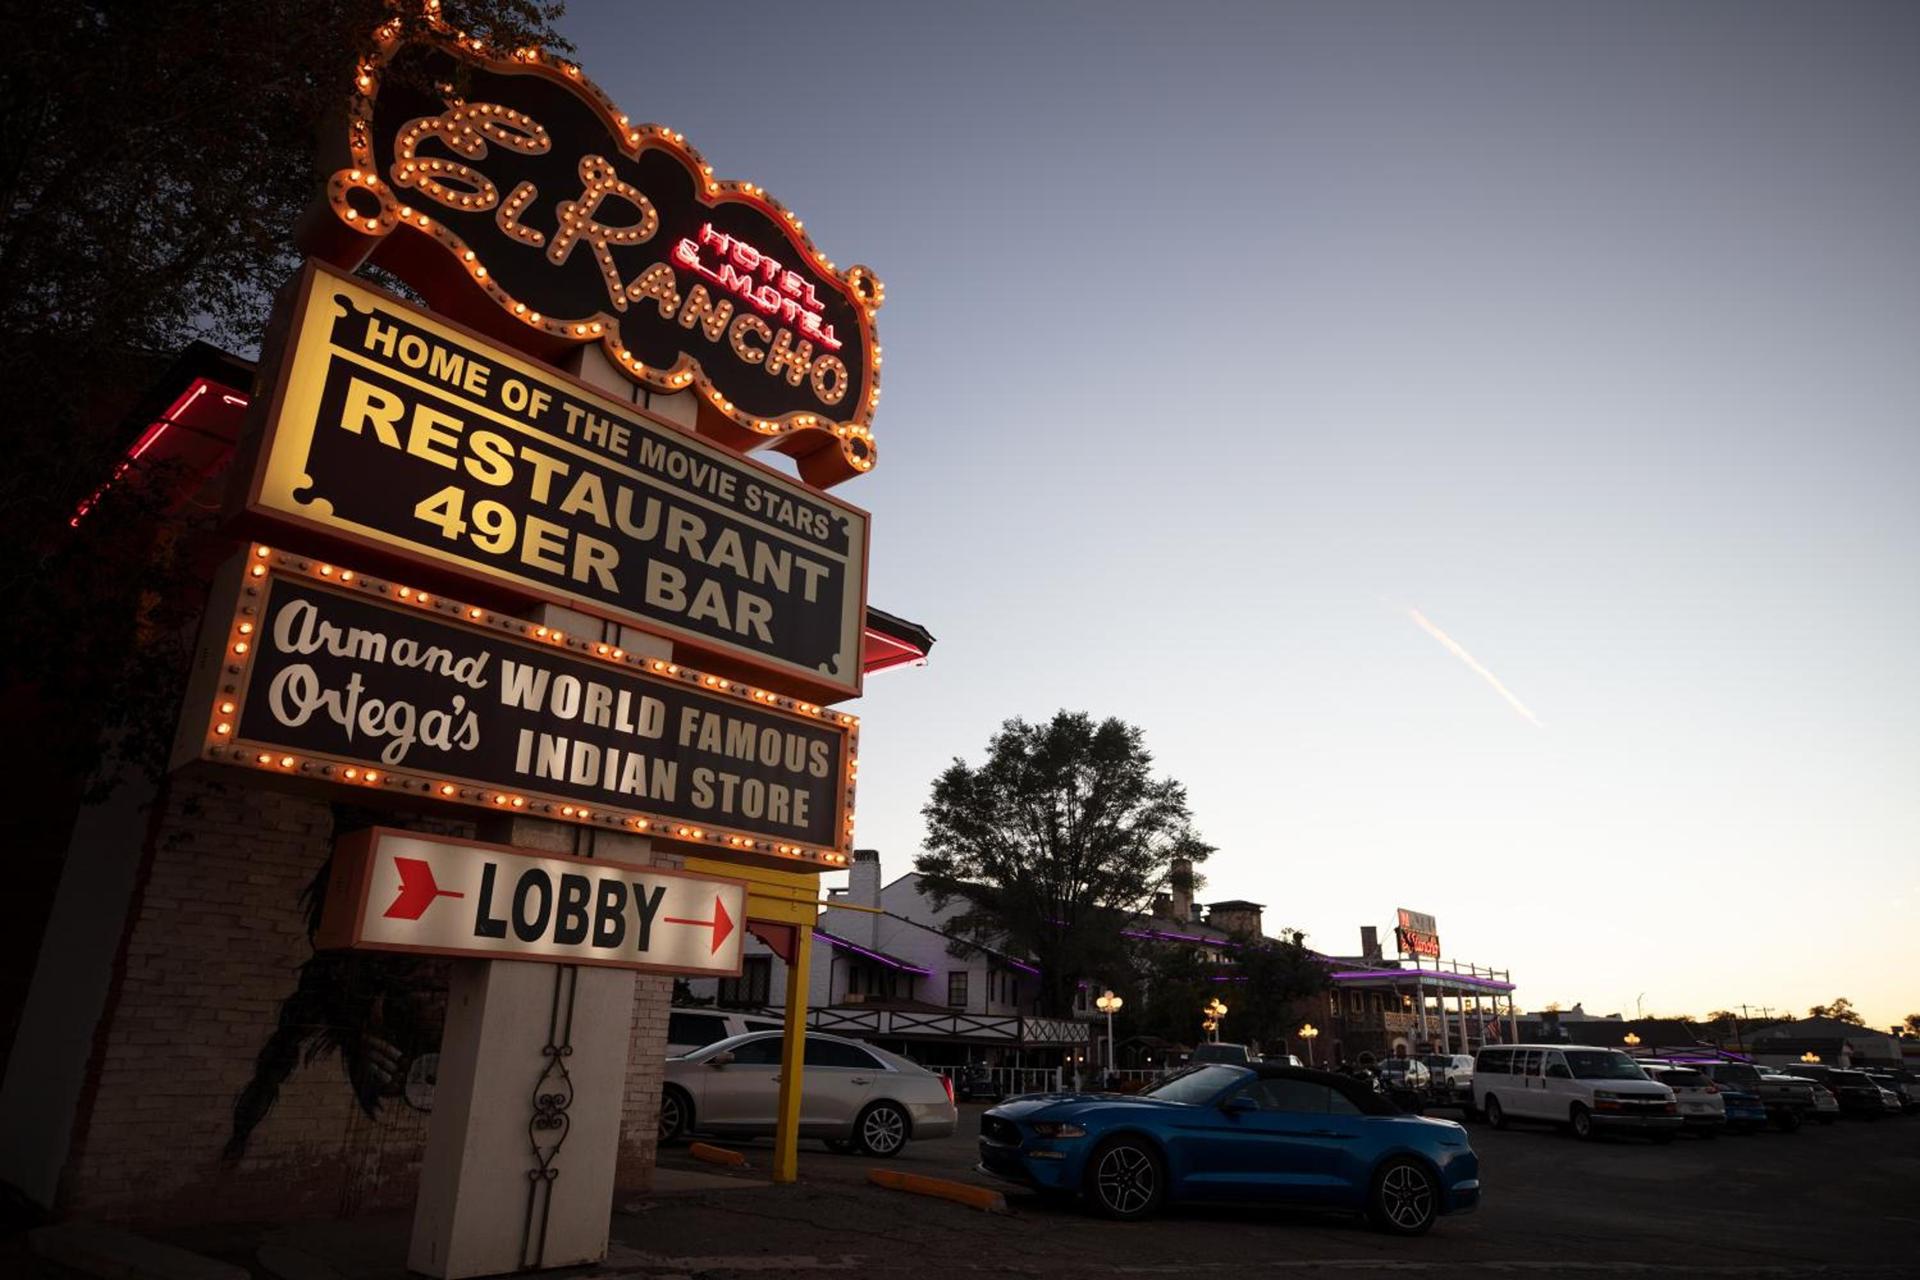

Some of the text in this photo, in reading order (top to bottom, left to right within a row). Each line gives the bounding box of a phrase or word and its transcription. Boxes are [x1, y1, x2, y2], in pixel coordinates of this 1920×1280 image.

[546, 155, 848, 404] RANCHO
[700, 223, 825, 312] HOTEL
[720, 264, 842, 349] MOTEL
[364, 317, 830, 541] HOME OF THE MOVIE STARS
[340, 377, 830, 604] RESTAURANT
[414, 486, 774, 644] 49ER BAR
[273, 600, 491, 689] Armand
[269, 664, 480, 765] Ortega's
[500, 659, 830, 778] WORLD FAMOUS
[515, 728, 811, 829] INDIAN STORE
[473, 862, 667, 952] LOBBY
